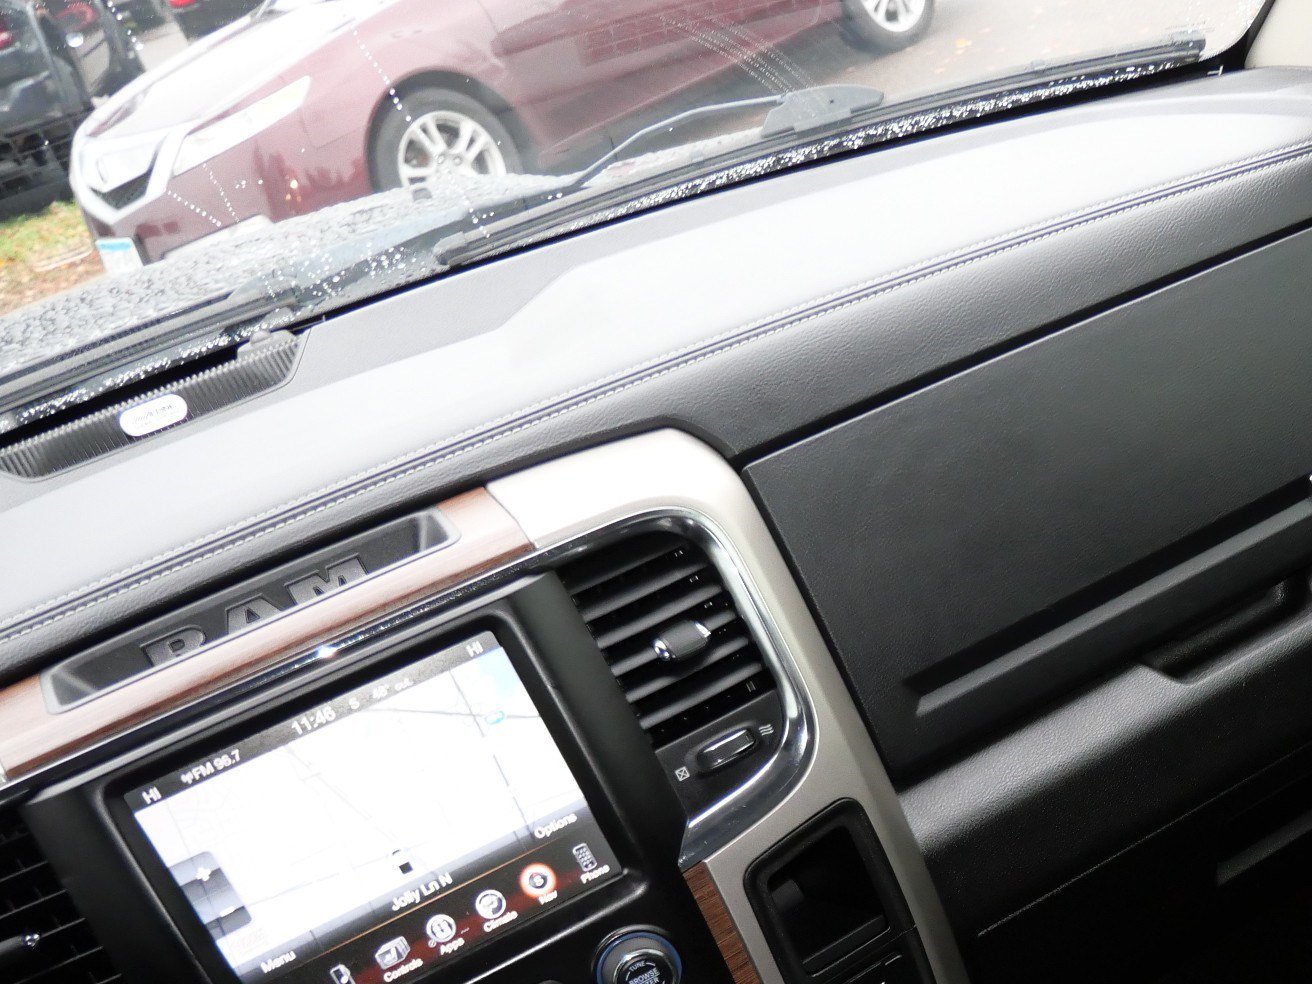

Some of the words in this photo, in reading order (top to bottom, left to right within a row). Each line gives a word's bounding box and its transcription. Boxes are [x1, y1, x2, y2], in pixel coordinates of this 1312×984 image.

[140, 553, 369, 668] RAM
[466, 641, 484, 657] HI
[291, 706, 336, 734] 11:46
[192, 762, 215, 780] FM
[142, 786, 162, 804] HI
[534, 813, 577, 839] Options
[580, 864, 610, 884] Phone
[391, 887, 421, 911] Jolly
[439, 938, 465, 955] Apps
[260, 951, 297, 973] Menu
[383, 958, 423, 983] Controls
[629, 960, 647, 972] TUNE
